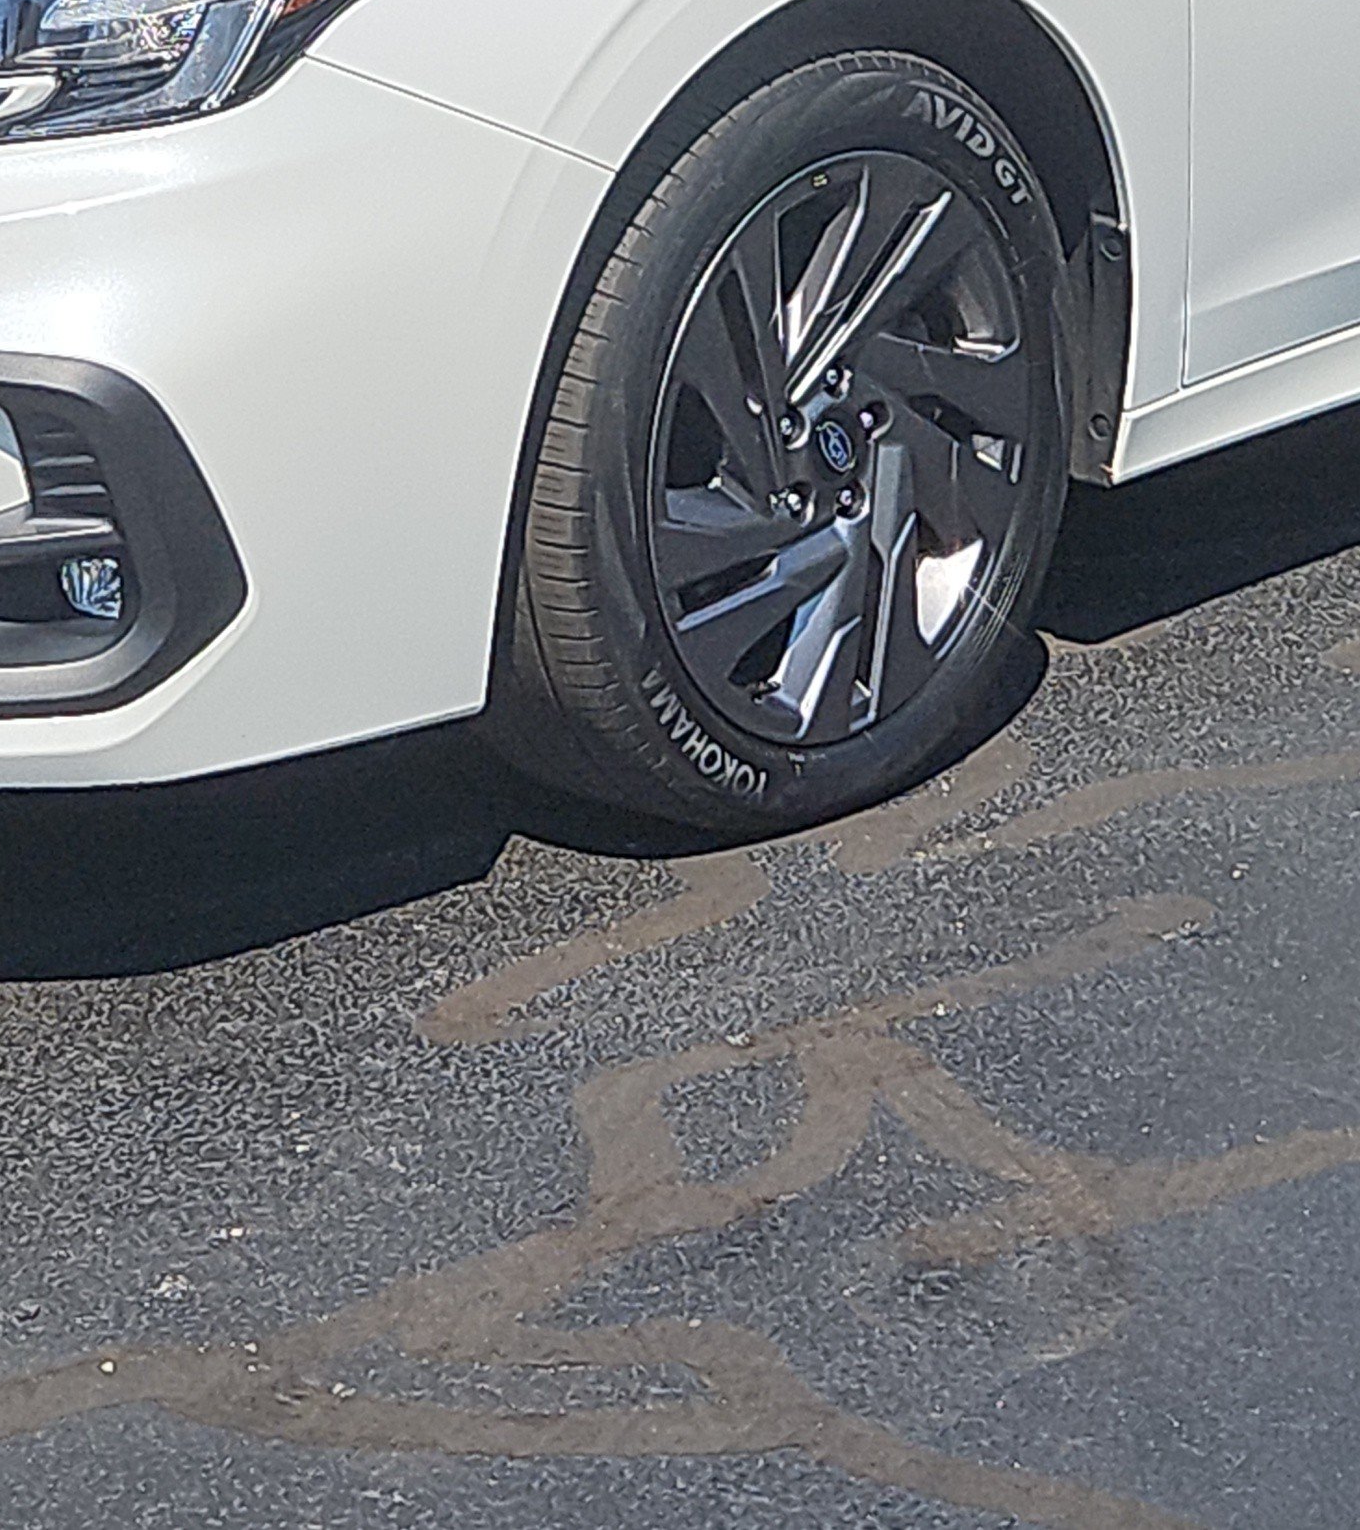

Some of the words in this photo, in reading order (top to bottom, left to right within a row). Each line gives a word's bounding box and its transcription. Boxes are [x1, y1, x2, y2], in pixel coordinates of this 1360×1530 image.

[901, 90, 995, 157] AVID
[995, 158, 1033, 204] GT
[641, 662, 767, 803] YOKOHAMA
